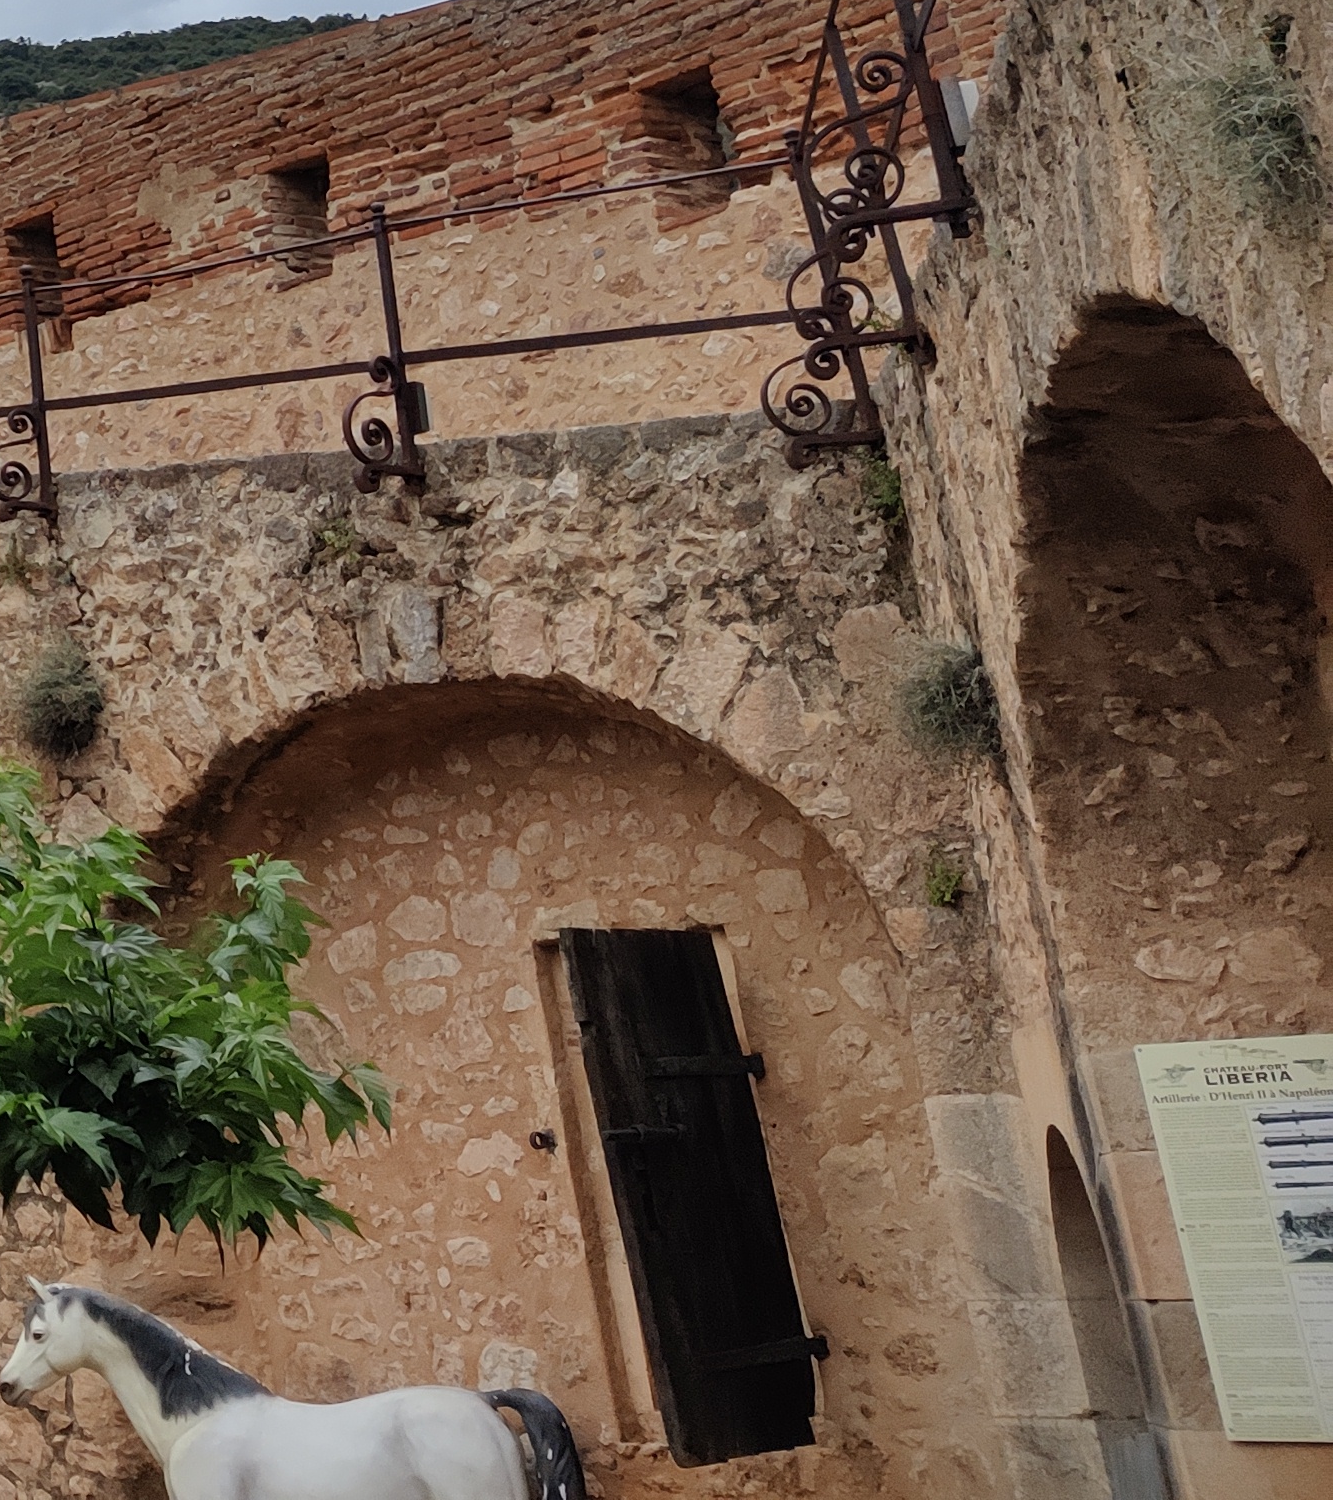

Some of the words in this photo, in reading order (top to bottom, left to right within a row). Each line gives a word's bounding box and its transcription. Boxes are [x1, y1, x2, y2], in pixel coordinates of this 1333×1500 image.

[1204, 1071, 1293, 1085] LIBERIA
[1152, 1093, 1200, 1104] Artillerie
[1209, 1088, 1255, 1101] D'Henri
